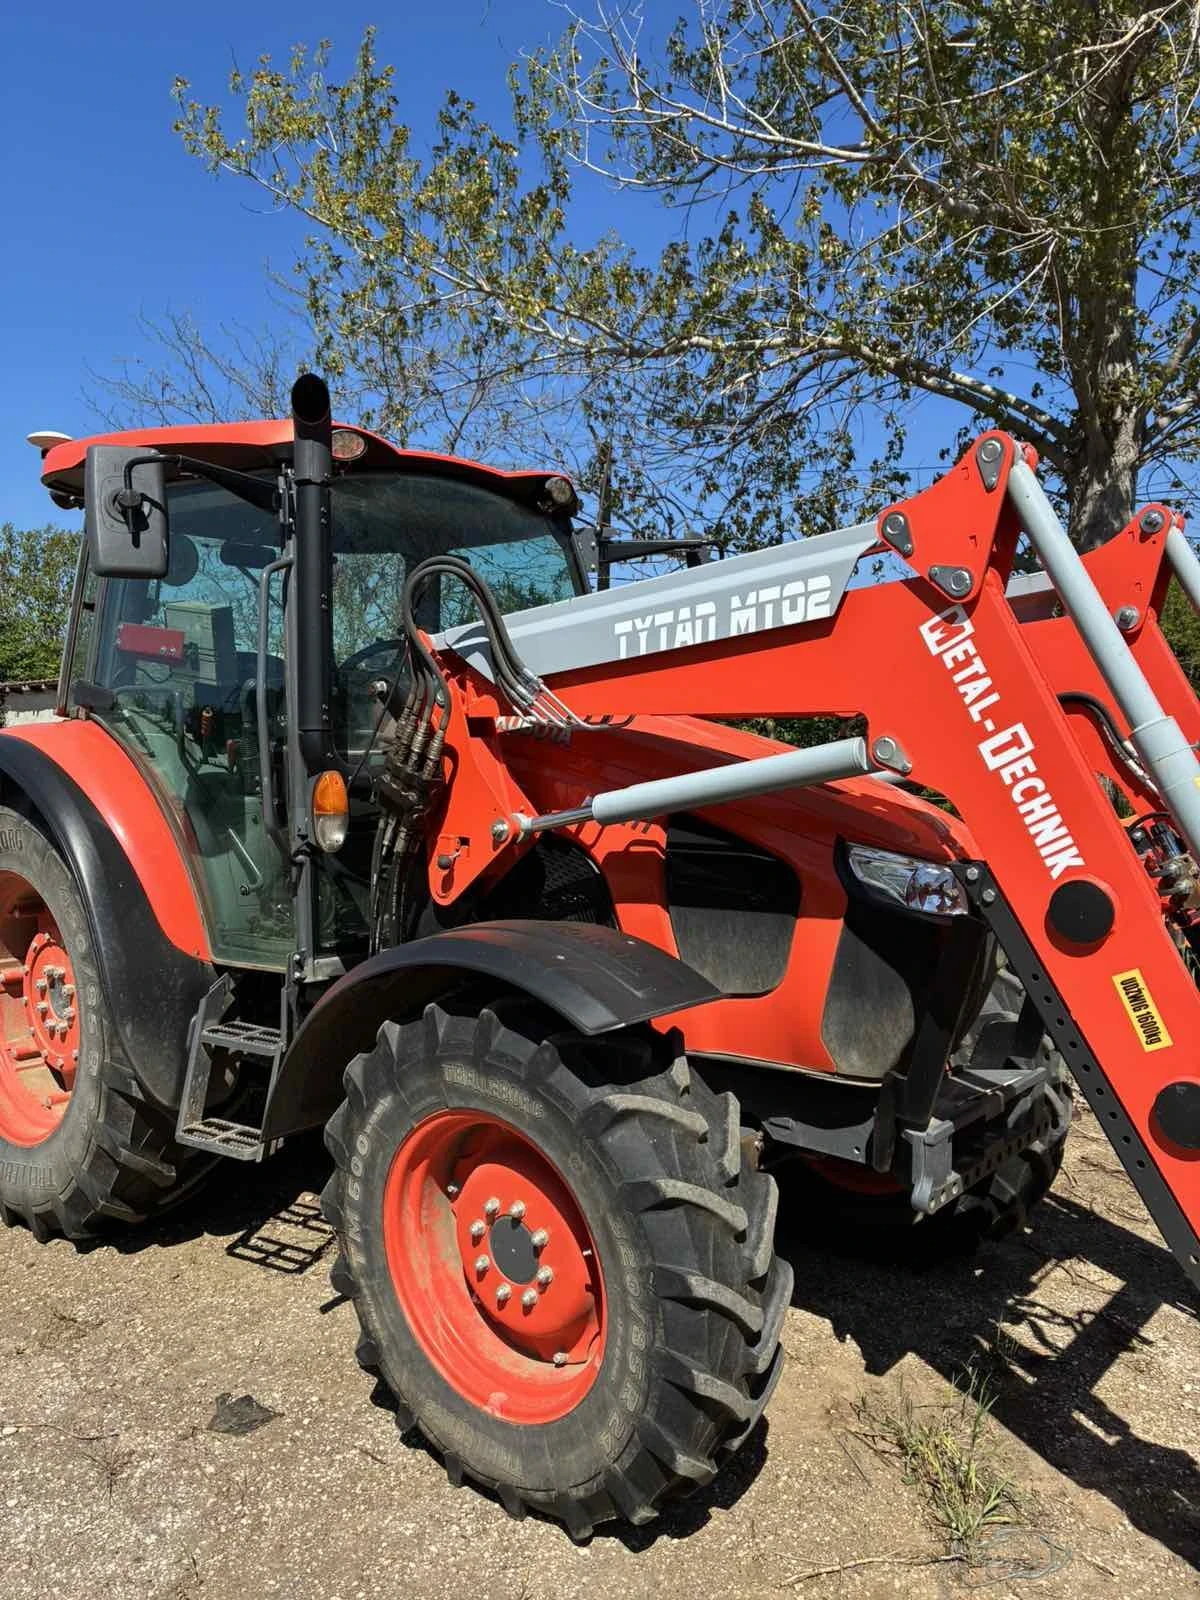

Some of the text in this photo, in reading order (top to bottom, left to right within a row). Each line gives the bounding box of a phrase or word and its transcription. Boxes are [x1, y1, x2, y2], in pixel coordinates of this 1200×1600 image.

[614, 601, 717, 659] TYTAN
[919, 603, 1086, 880] METAL-TECHNIK
[1120, 976, 1163, 1045] UDŹWIG 1600kg
